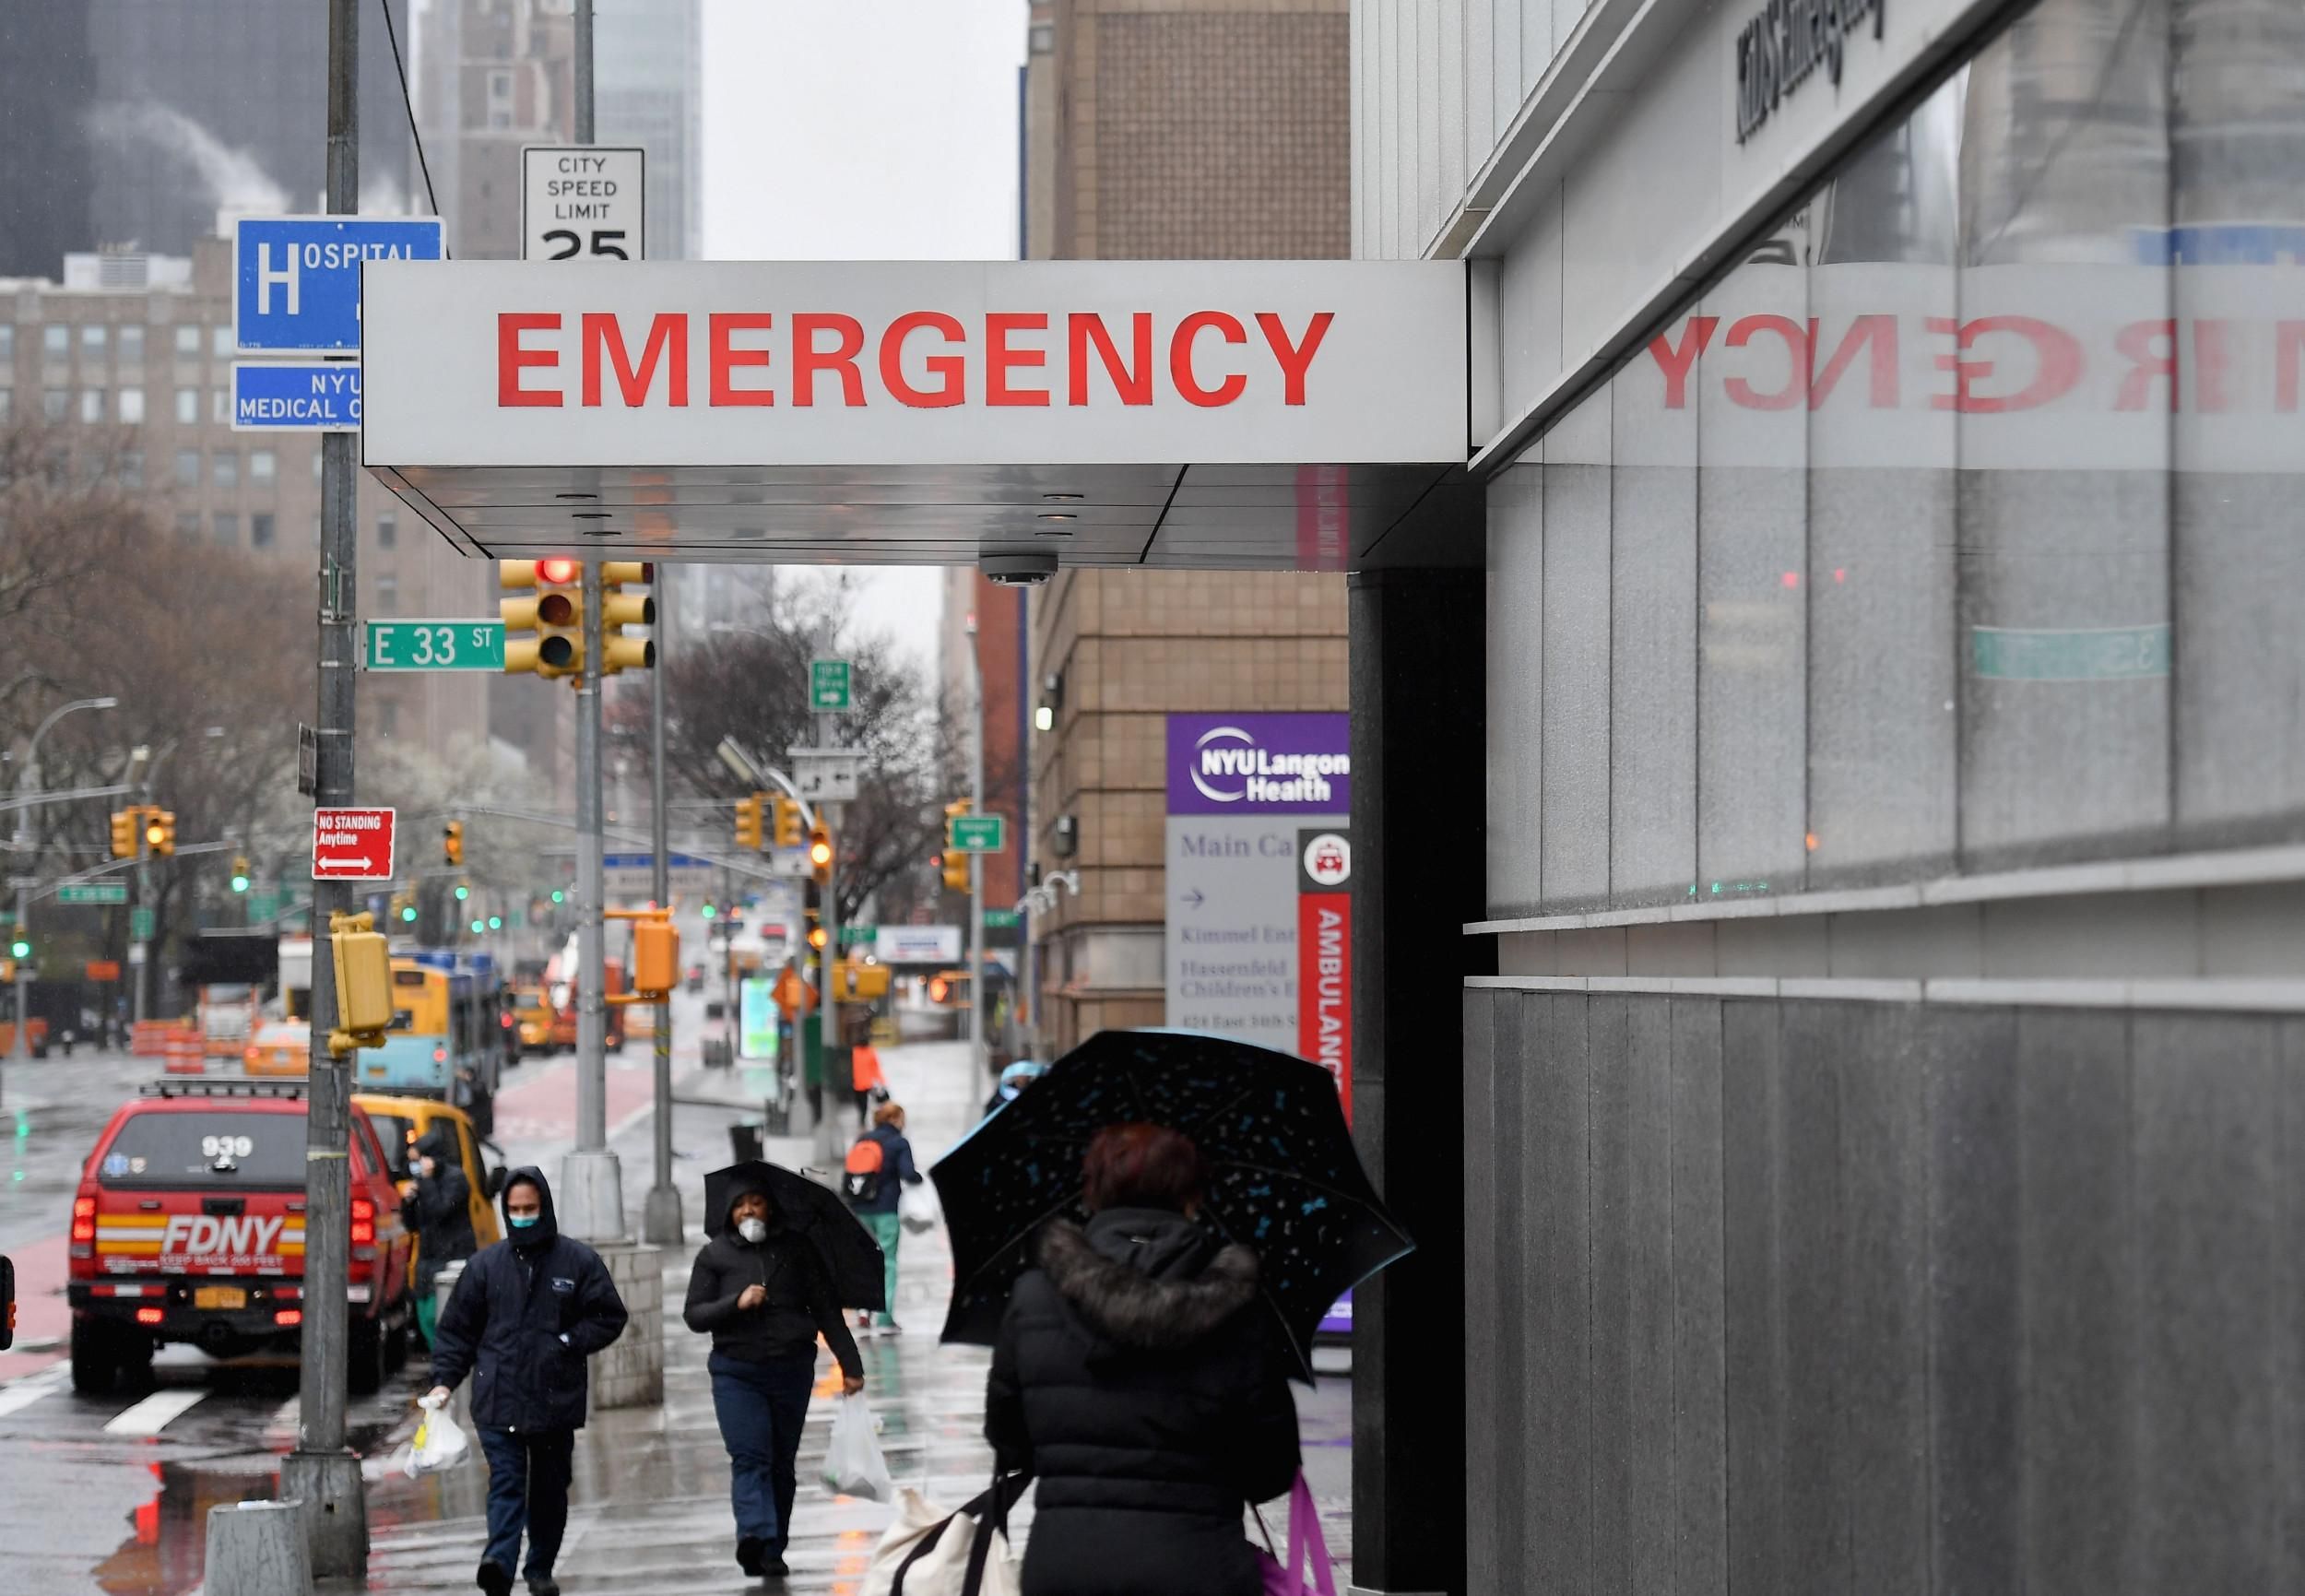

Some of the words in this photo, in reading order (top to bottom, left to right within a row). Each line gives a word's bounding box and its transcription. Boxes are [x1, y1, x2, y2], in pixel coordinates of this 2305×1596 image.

[559, 158, 606, 172] CITY
[548, 181, 617, 196] SPEED
[556, 204, 609, 219] LIMIT
[542, 230, 629, 260] 25
[498, 311, 1335, 408] EMERGENCY
[312, 374, 361, 395] NYU
[240, 398, 337, 419] MEDICAL
[375, 627, 395, 664] E
[412, 627, 455, 665] 33
[472, 628, 492, 647] ST
[1201, 749, 1256, 775] NYU
[1247, 776, 1331, 802] Health
[319, 815, 333, 830] NO
[335, 815, 381, 830] STANDING
[319, 831, 358, 848] Anytime
[1181, 834, 1250, 857] Main
[1181, 927, 1258, 945] Kimmel
[1180, 981, 1279, 999] Children's
[202, 1135, 254, 1158] 939
[161, 1214, 284, 1256] FDNY
